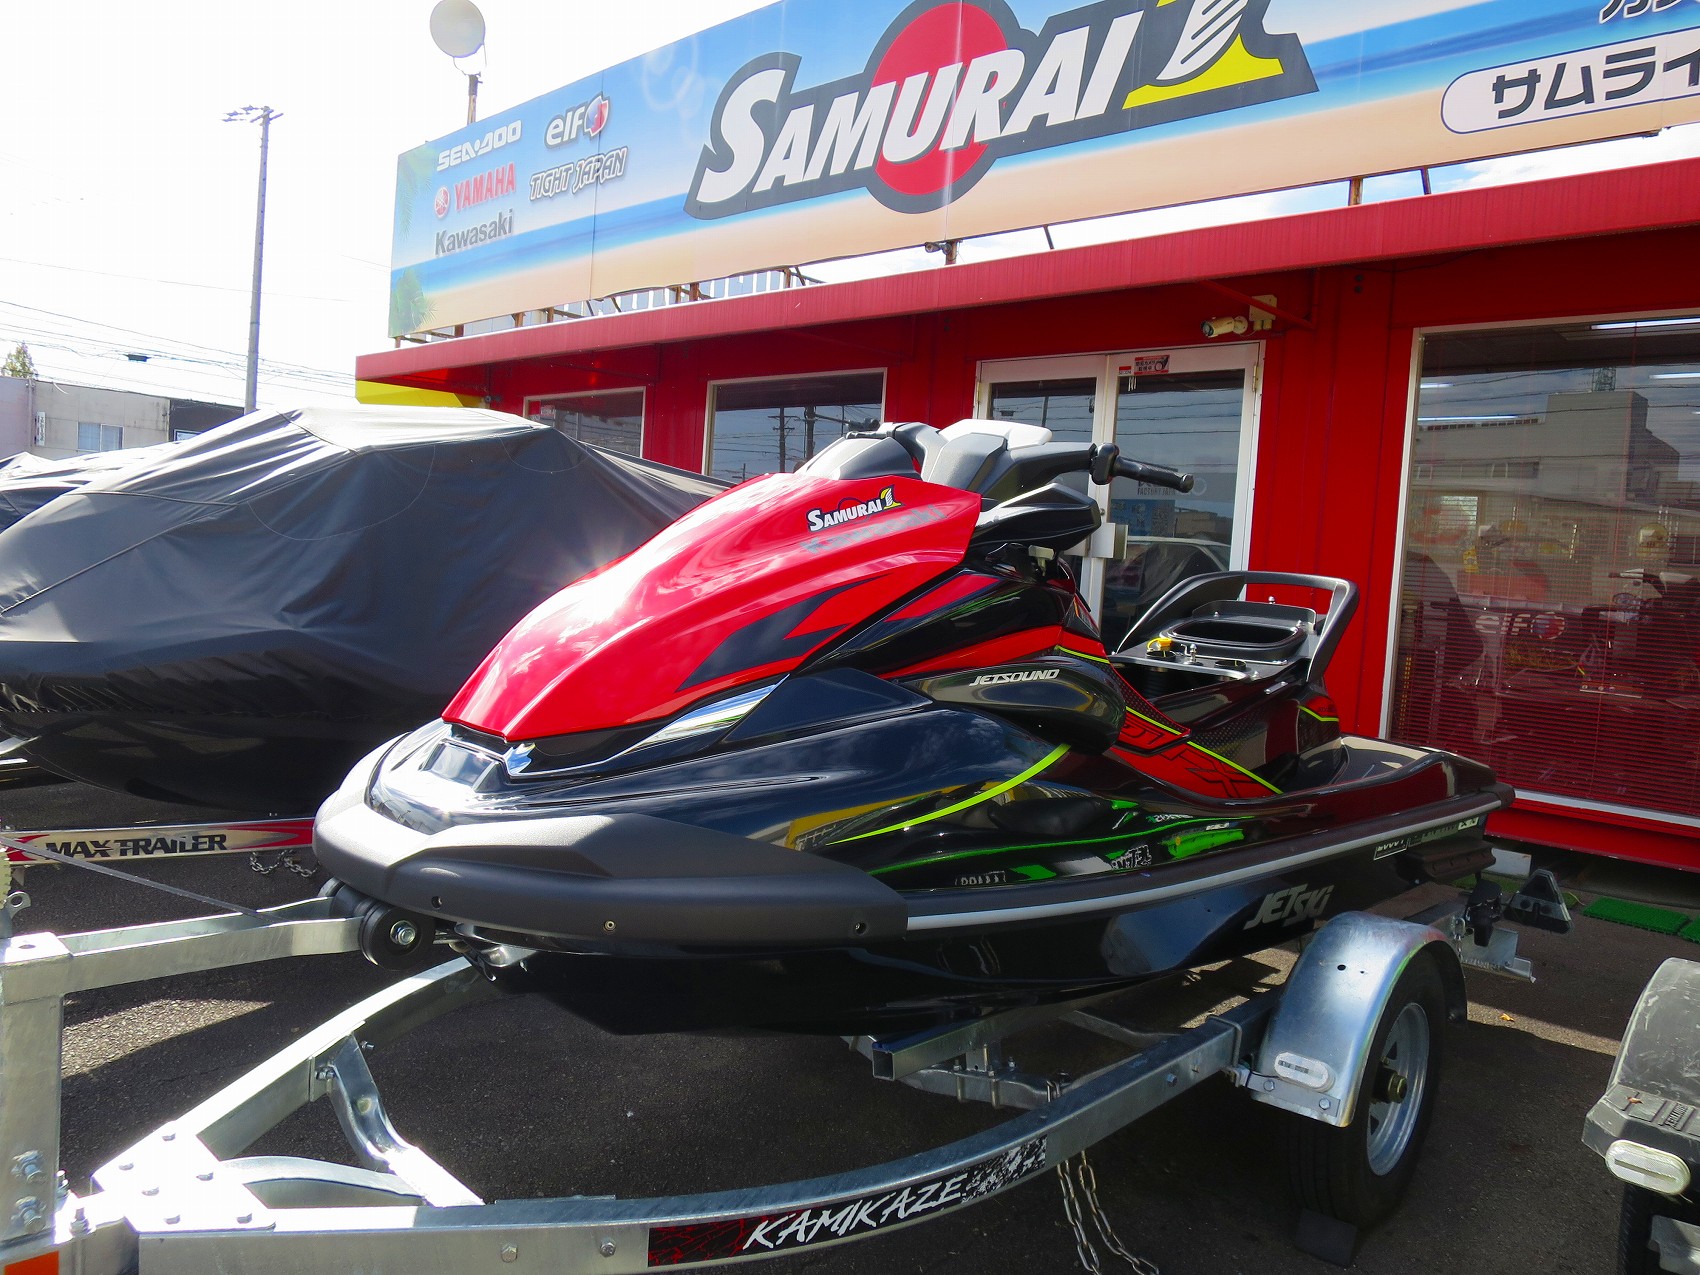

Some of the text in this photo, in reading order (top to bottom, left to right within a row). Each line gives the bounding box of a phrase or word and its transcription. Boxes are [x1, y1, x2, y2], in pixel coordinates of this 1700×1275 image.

[545, 104, 586, 148] elf
[696, 9, 1144, 203] SAMURAI
[454, 162, 515, 212] YAMAHA
[530, 147, 628, 202] TIGHT JAPAN
[435, 208, 514, 255] Kawasaki
[807, 499, 883, 532] SAMURAI
[969, 669, 1060, 687] JETSOUND
[45, 834, 227, 859] MAX TRAILER
[743, 1173, 968, 1250] KAMIKAZE
